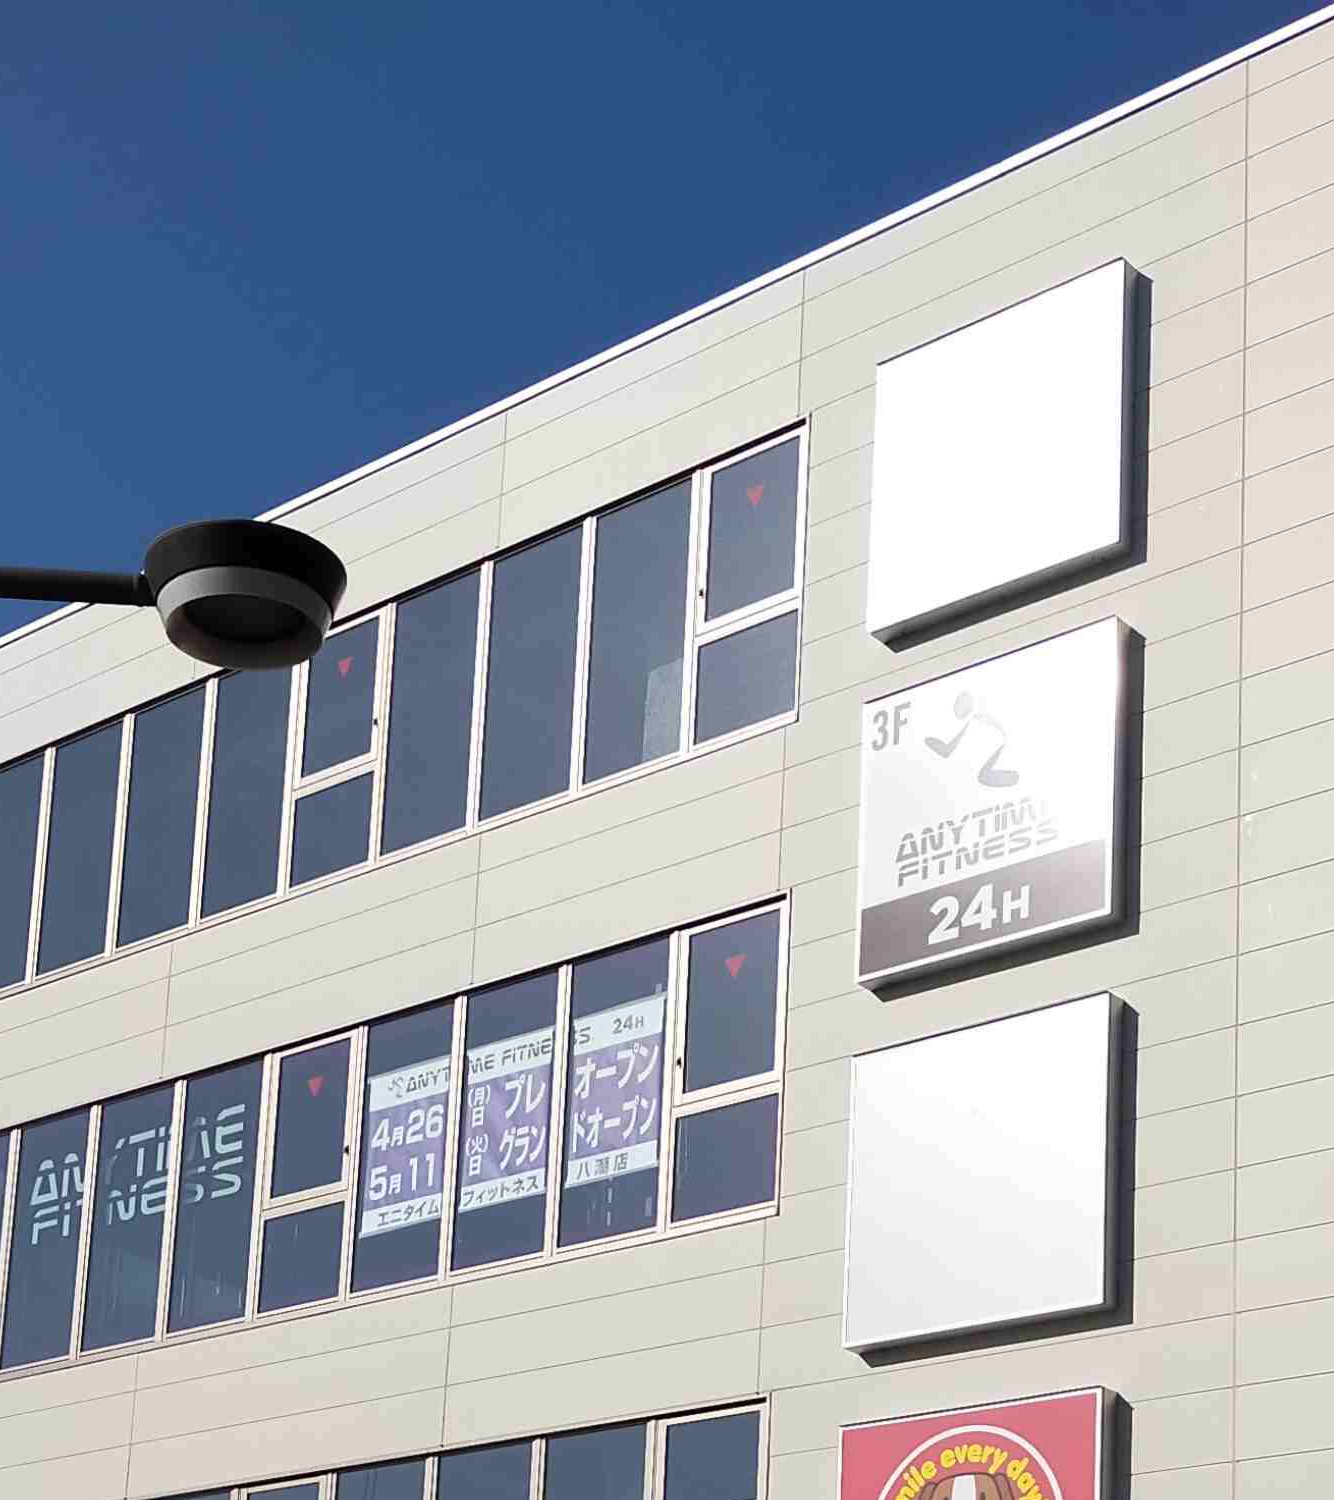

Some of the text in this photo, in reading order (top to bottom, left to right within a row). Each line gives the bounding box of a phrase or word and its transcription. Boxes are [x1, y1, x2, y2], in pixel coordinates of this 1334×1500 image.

[871, 702, 911, 751] 3F
[896, 797, 1045, 863] ANYTIM
[897, 819, 1059, 888] FITNESS
[927, 883, 1031, 945] 24H
[613, 1014, 644, 1034] 24H
[31, 1155, 244, 1246] FINESS
